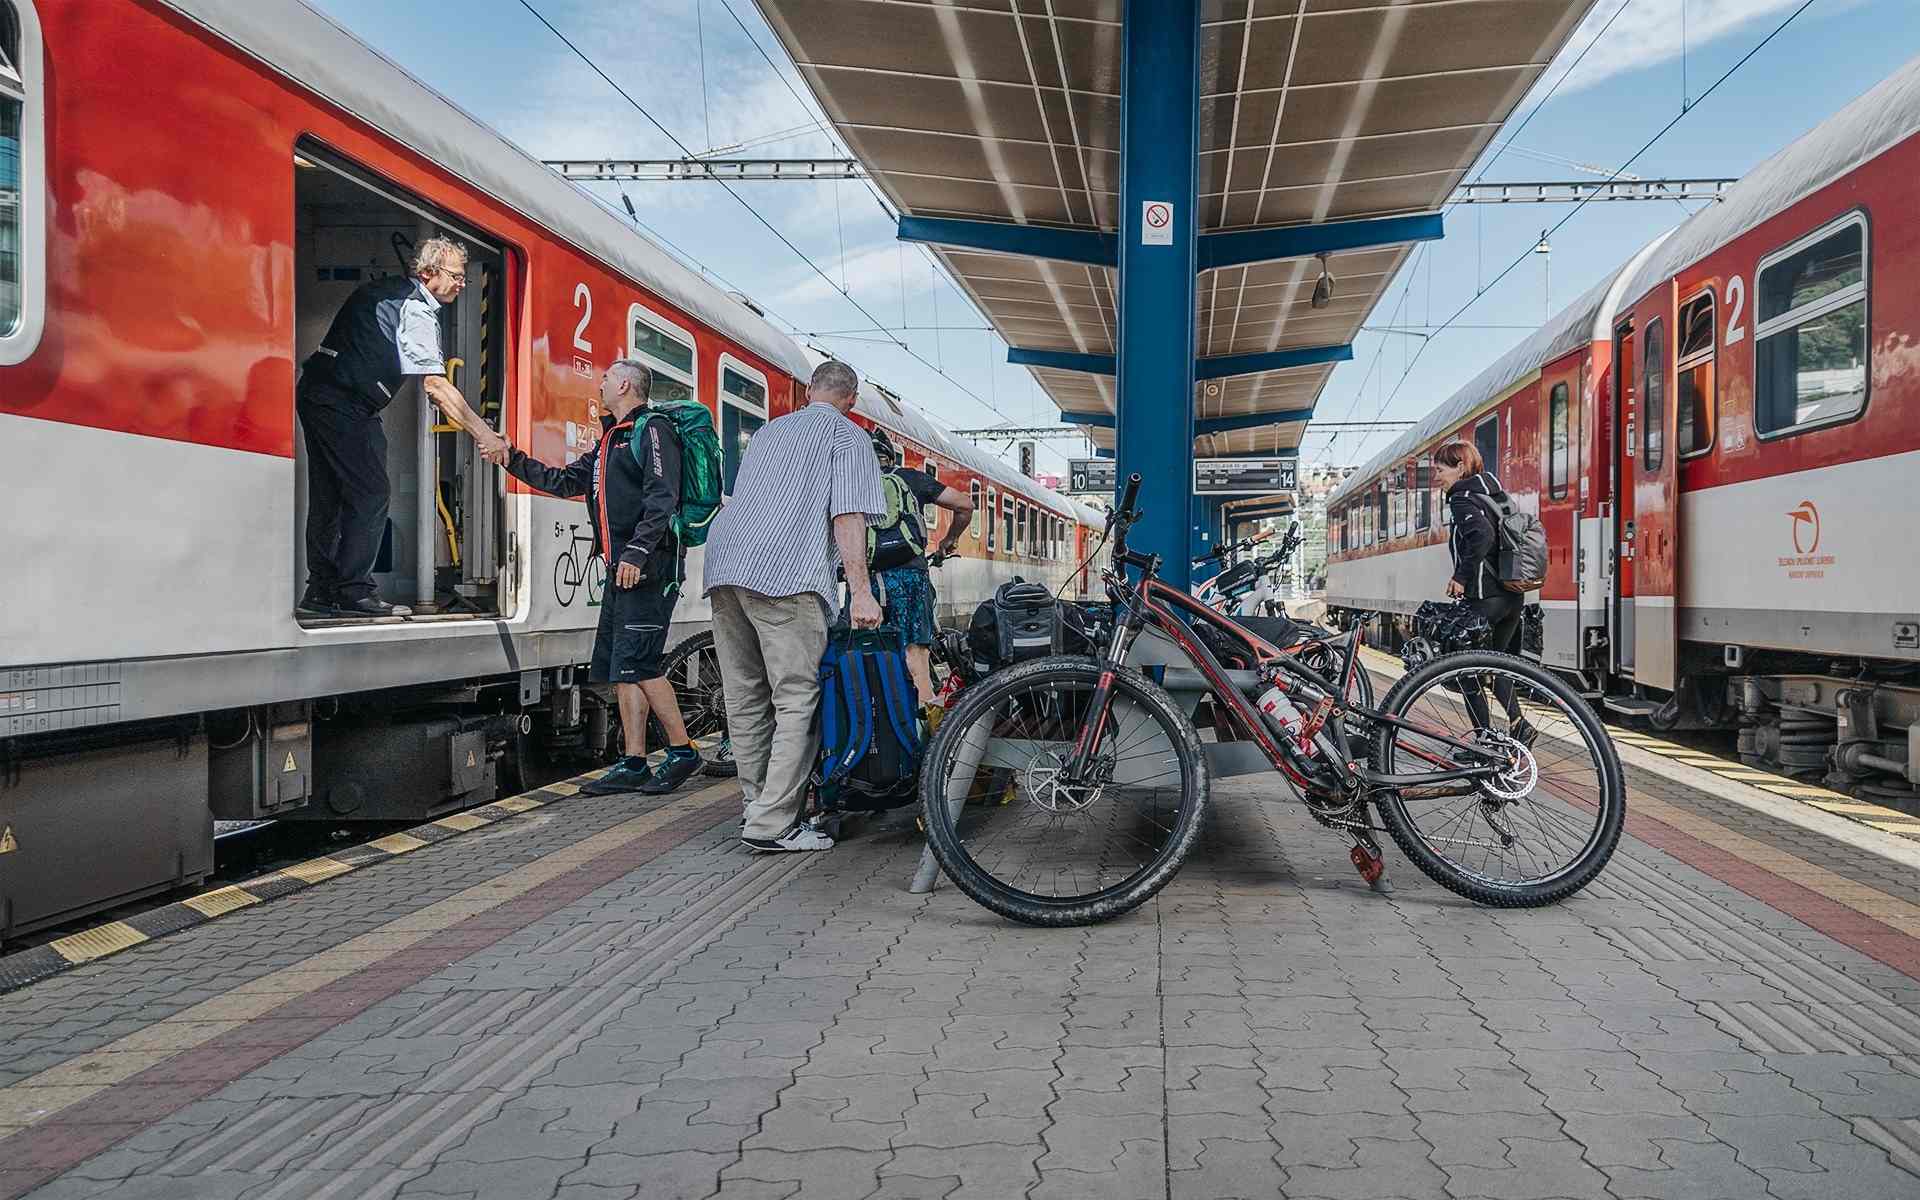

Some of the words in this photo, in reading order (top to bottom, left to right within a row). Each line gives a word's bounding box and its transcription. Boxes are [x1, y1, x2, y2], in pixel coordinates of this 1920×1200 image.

[573, 283, 592, 353] 2
[1725, 275, 1745, 346] 2
[1506, 406, 1512, 448] 1
[1073, 473, 1086, 489] 10
[1281, 471, 1295, 487] 14
[555, 521, 564, 537] 5+
